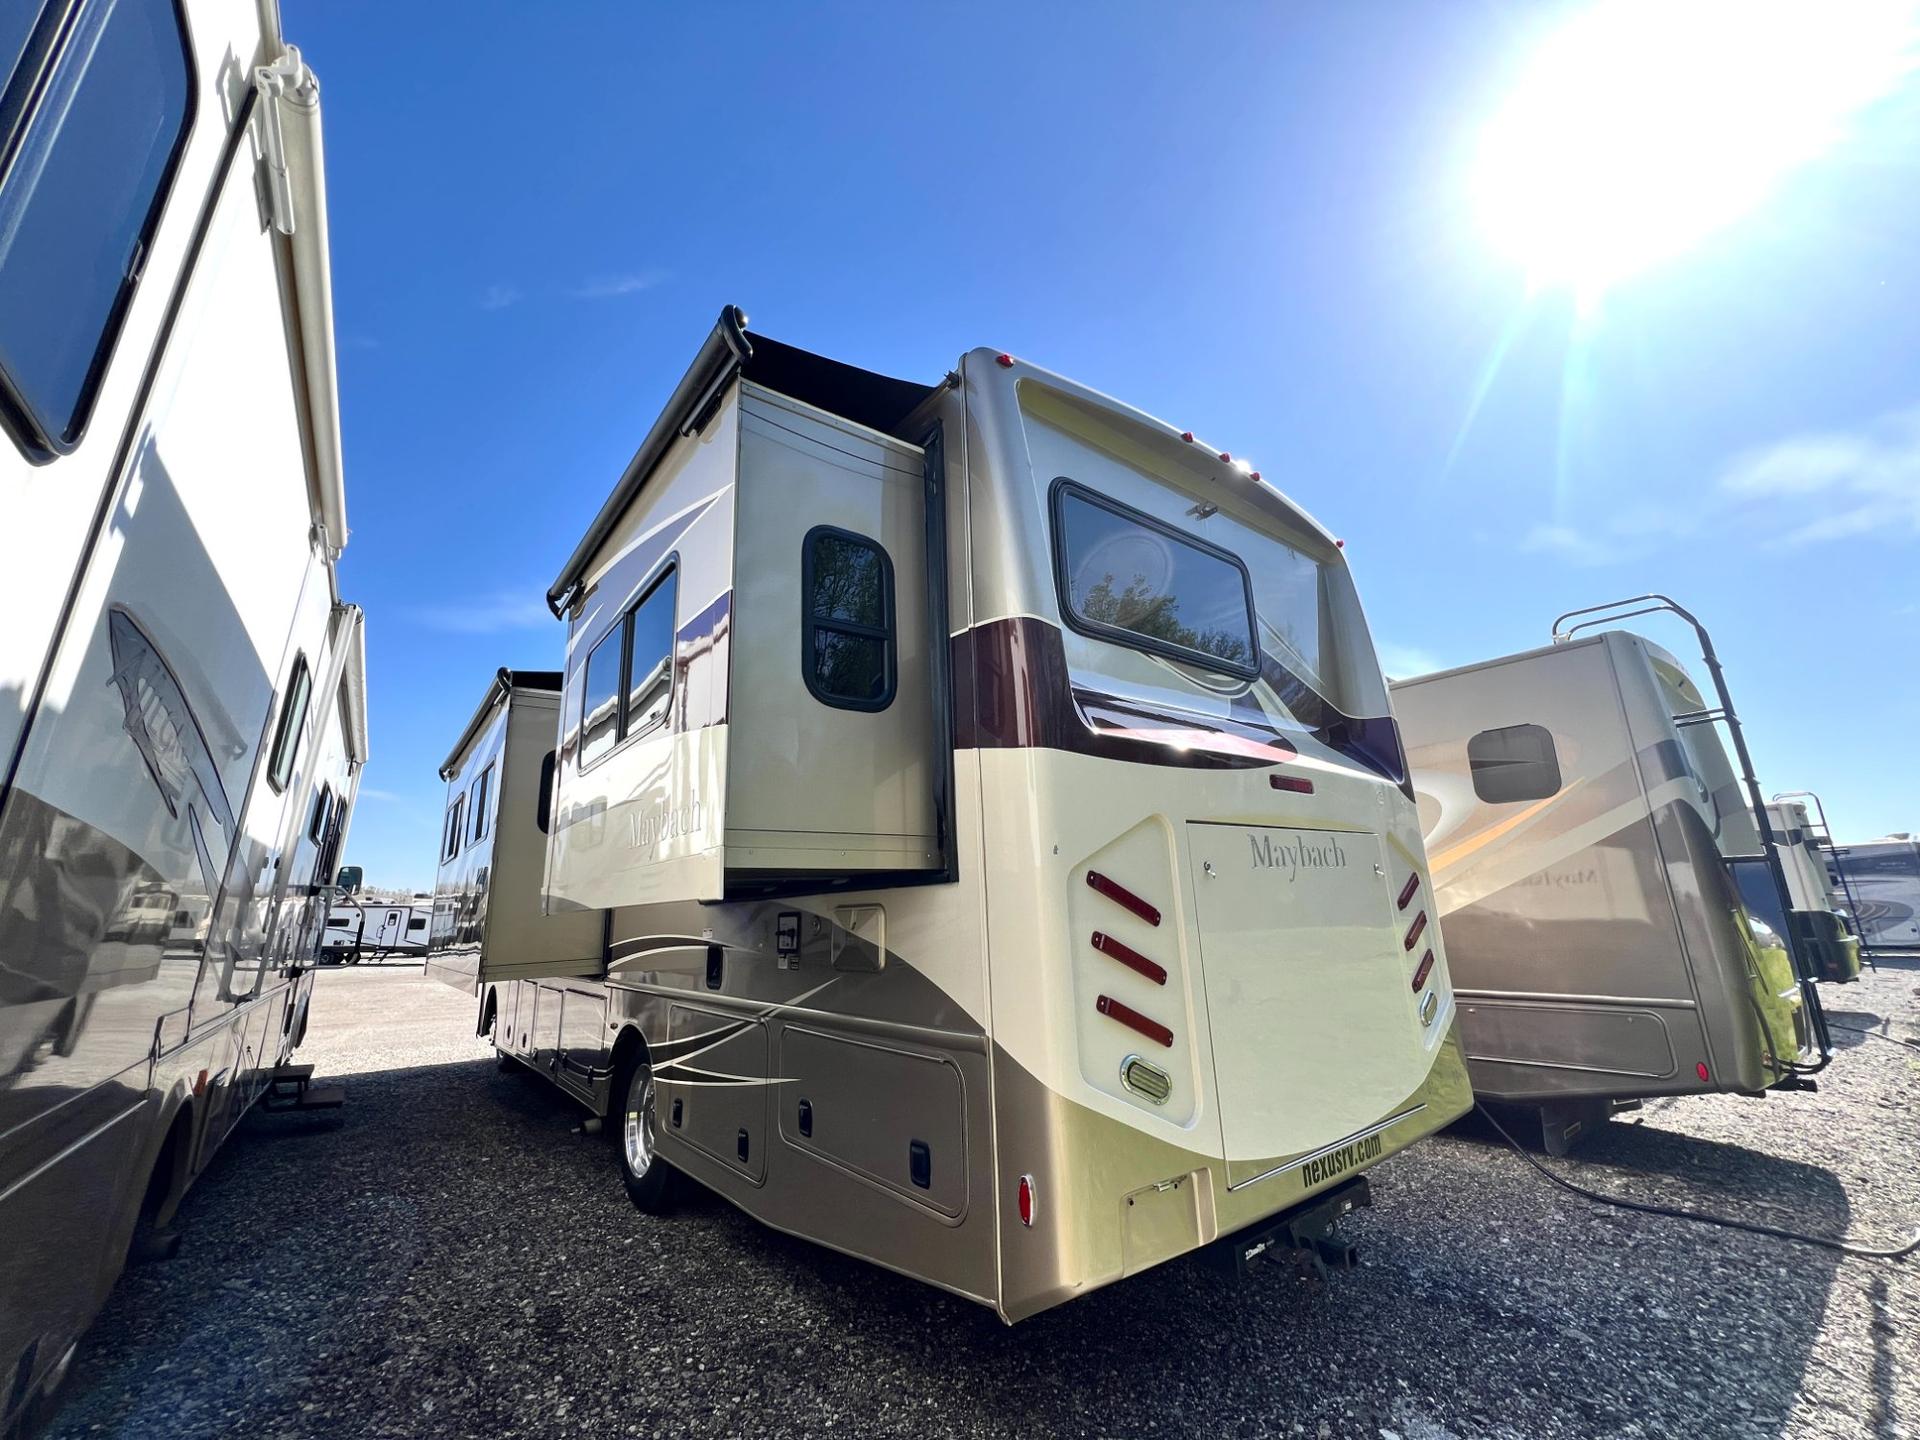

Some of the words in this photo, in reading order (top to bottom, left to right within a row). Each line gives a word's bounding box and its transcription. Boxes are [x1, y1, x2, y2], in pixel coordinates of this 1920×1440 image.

[629, 789, 702, 861] Maybach
[1248, 832, 1346, 882] Maybach
[1302, 1133, 1382, 1188] nexusrv.com
